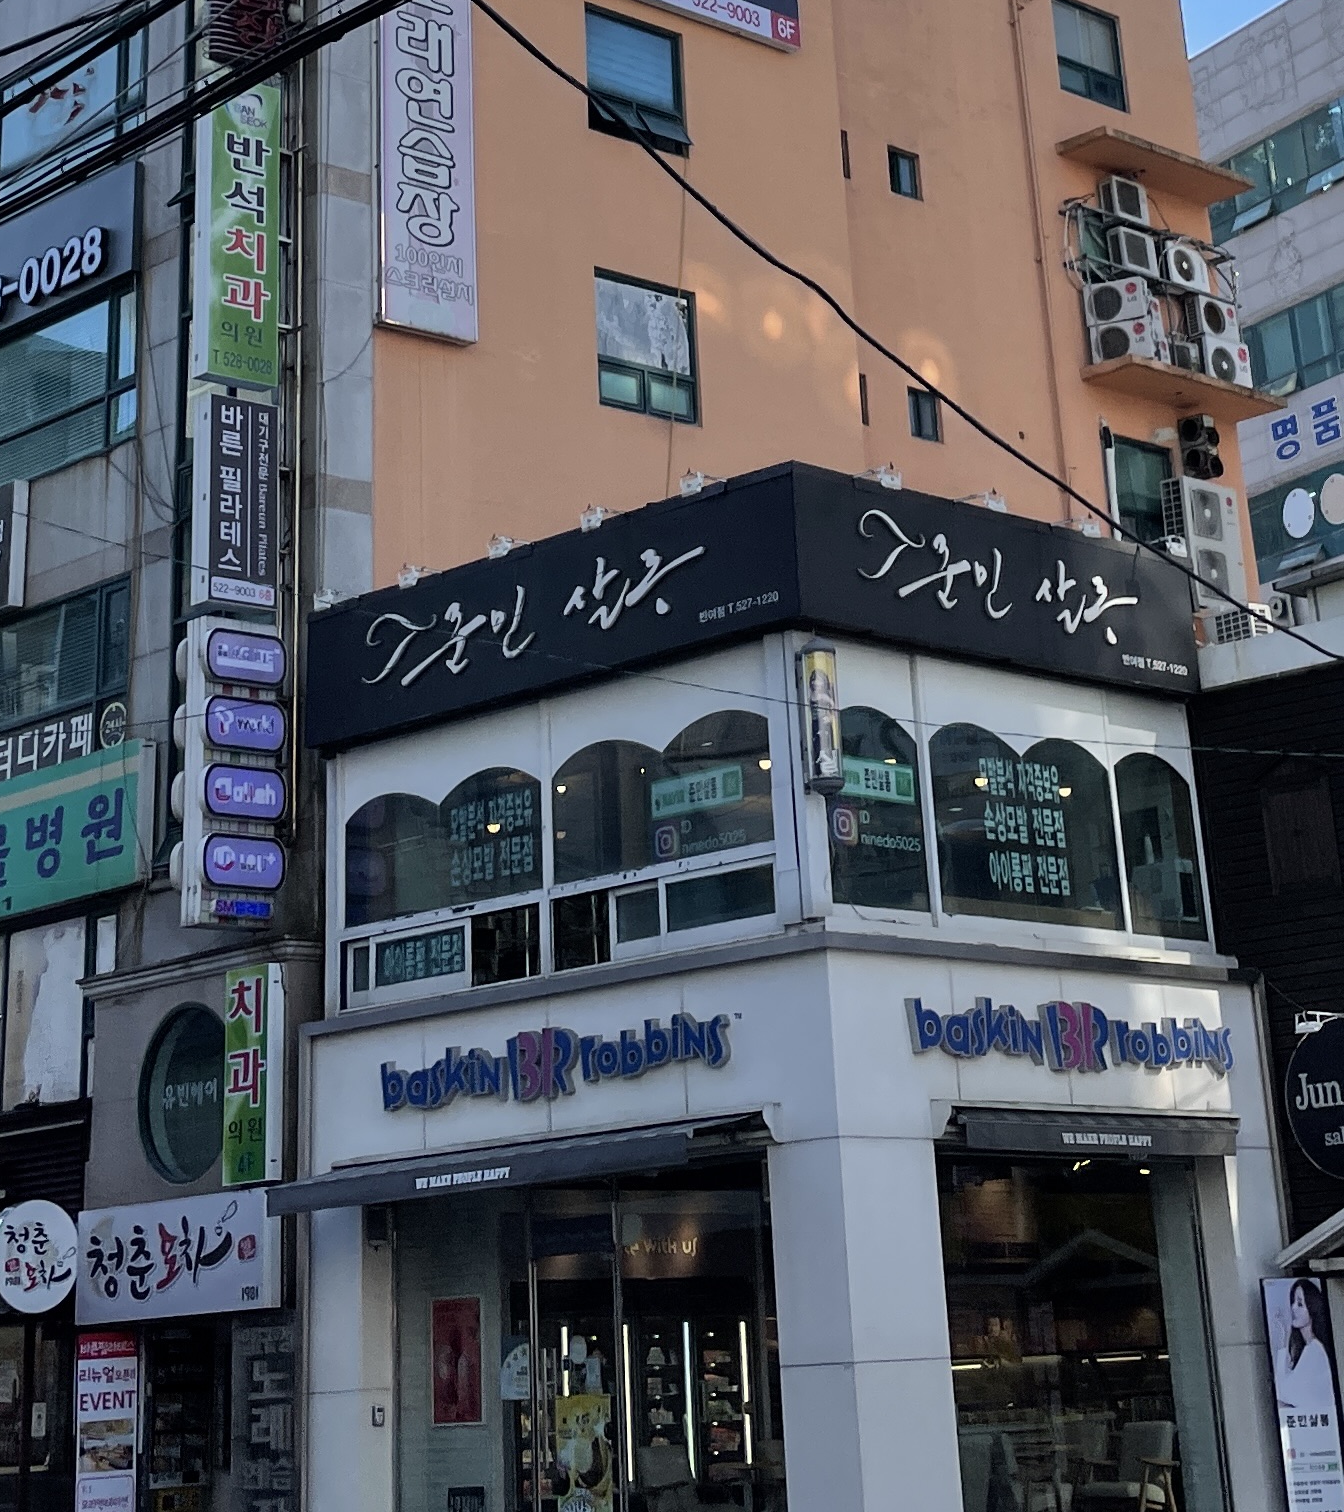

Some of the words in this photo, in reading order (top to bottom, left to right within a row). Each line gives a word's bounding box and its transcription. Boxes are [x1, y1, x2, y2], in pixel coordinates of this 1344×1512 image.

[776, 16, 796, 40] 6F
[222, 129, 272, 325] 반석치과
[220, 319, 264, 349] 의원
[218, 403, 244, 458] 바른
[217, 464, 244, 572] 필라테스
[212, 581, 257, 598] 522-9003
[858, 809, 871, 826] ID
[1031, 805, 1067, 850] 전문점
[1036, 854, 1072, 897] 전문점
[227, 975, 269, 1107] 치과
[1044, 999, 1110, 1073] BR
[506, 1026, 577, 1104] BR
[1294, 1071, 1343, 1112] Jun
[226, 1116, 266, 1146] 의원
[2, 1220, 51, 1257] 청춘
[78, 1366, 116, 1384] 리뉴얼
[78, 1389, 137, 1413] EVENT
